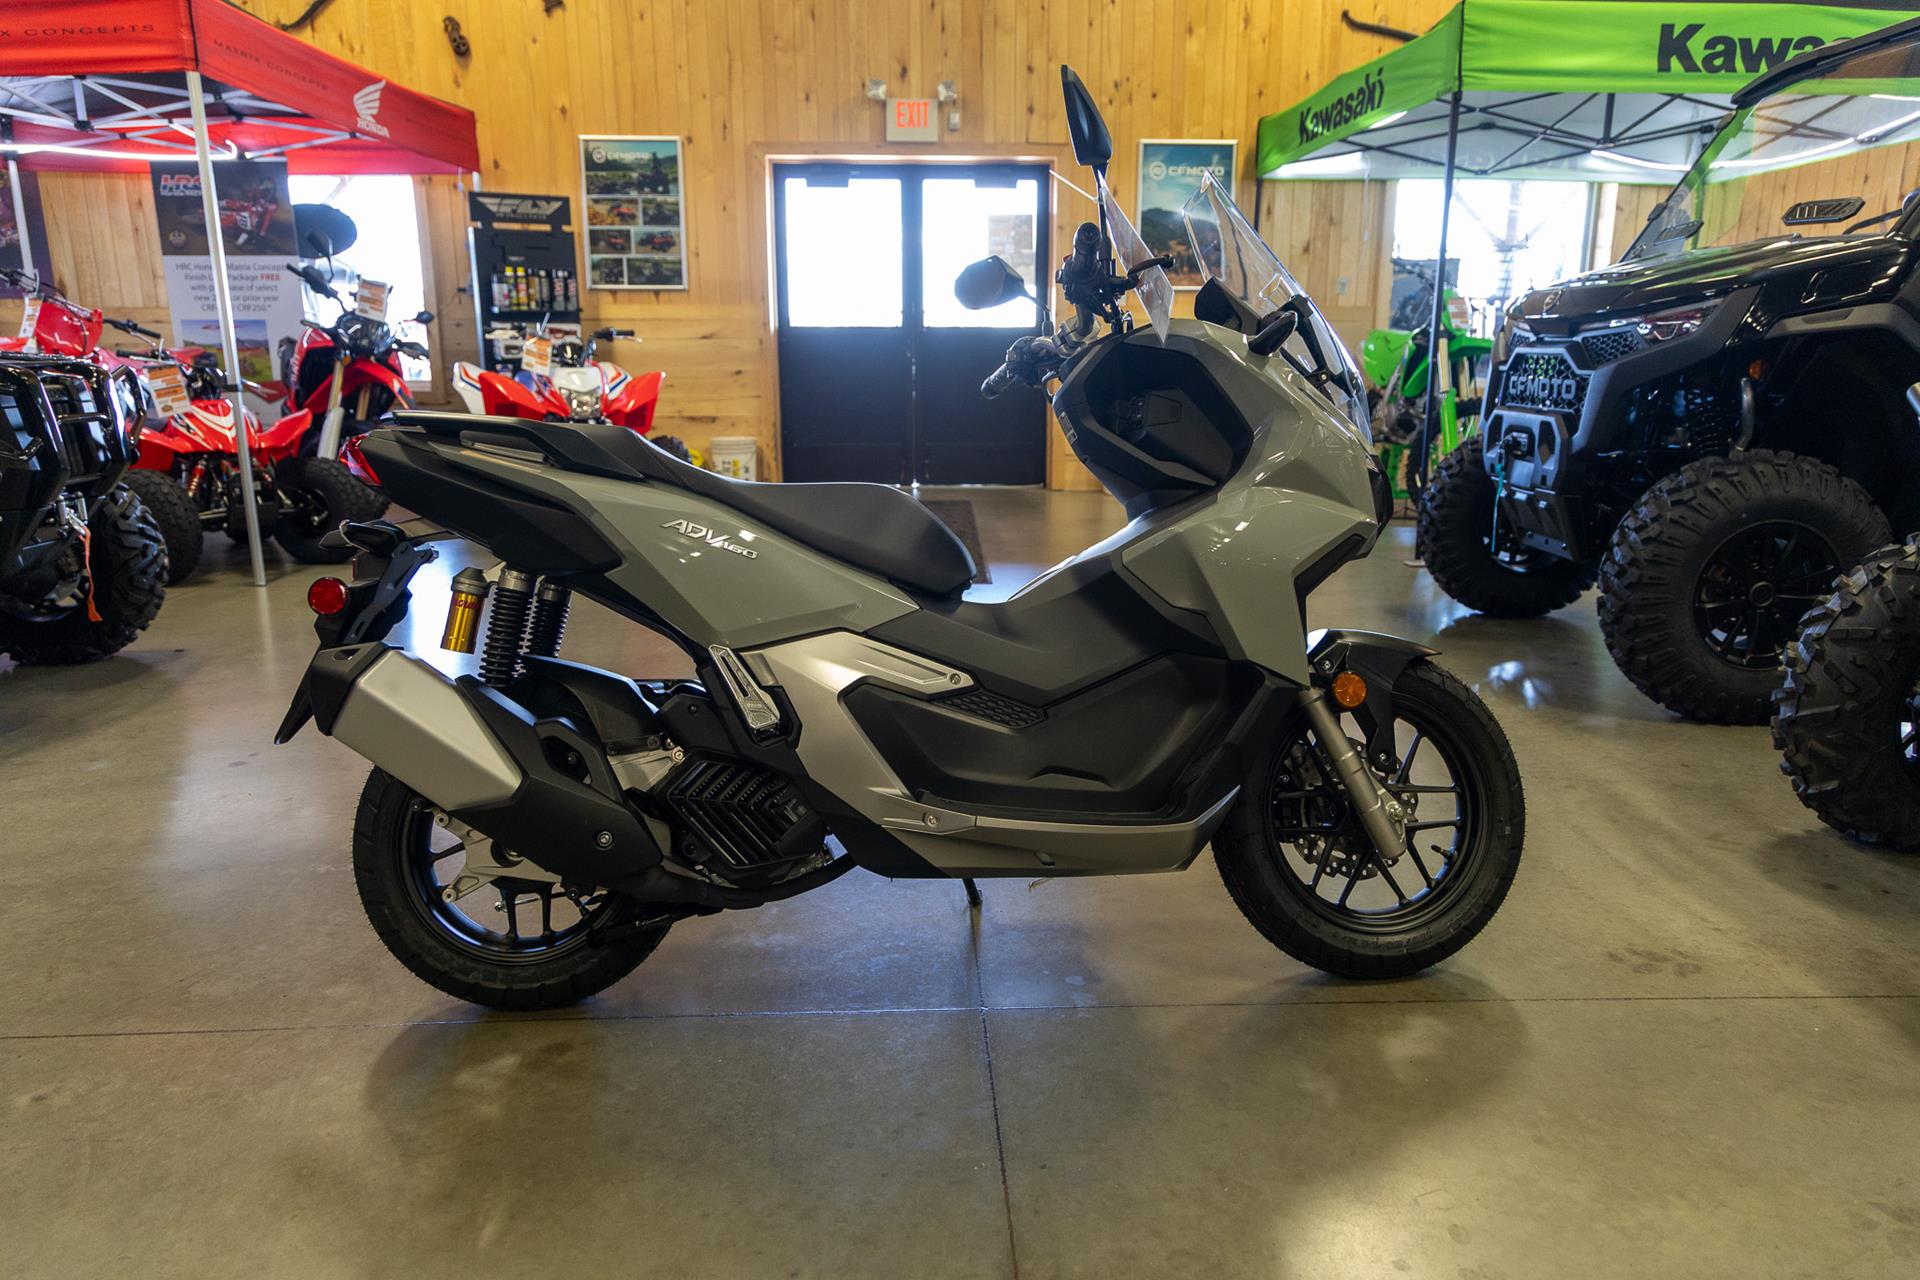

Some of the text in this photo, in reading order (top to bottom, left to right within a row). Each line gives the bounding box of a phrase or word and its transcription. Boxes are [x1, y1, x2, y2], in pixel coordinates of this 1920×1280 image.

[24, 24, 155, 37] CONCEPTS
[213, 38, 260, 64] MATRIX
[896, 101, 929, 129] EXIT
[1298, 66, 1385, 146] Kawasaki
[356, 117, 390, 139] HONDA
[260, 273, 281, 281] FREE
[1509, 376, 1577, 400] CFMOTO
